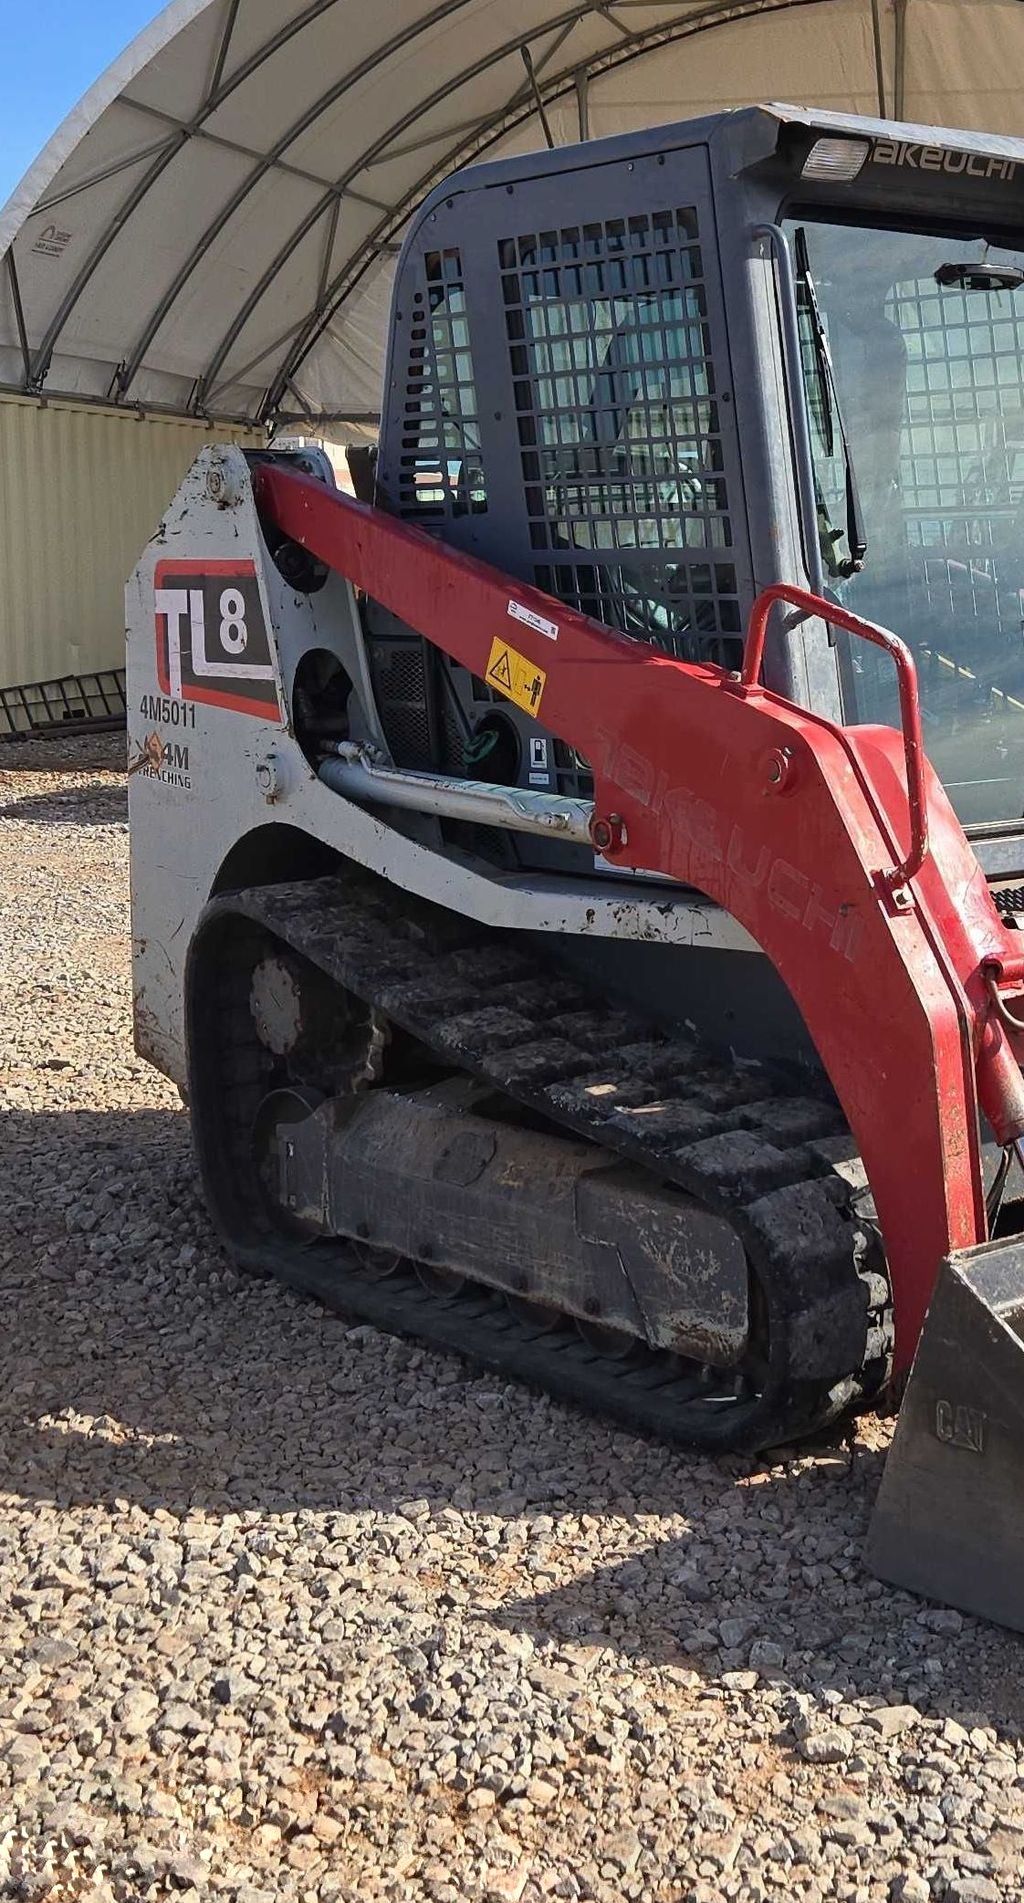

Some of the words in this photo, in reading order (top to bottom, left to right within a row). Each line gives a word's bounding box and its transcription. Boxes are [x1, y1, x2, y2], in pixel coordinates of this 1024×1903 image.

[868, 137, 1016, 180] AKEUCHI
[140, 694, 195, 729] 4M5011
[163, 741, 190, 771] 4M
